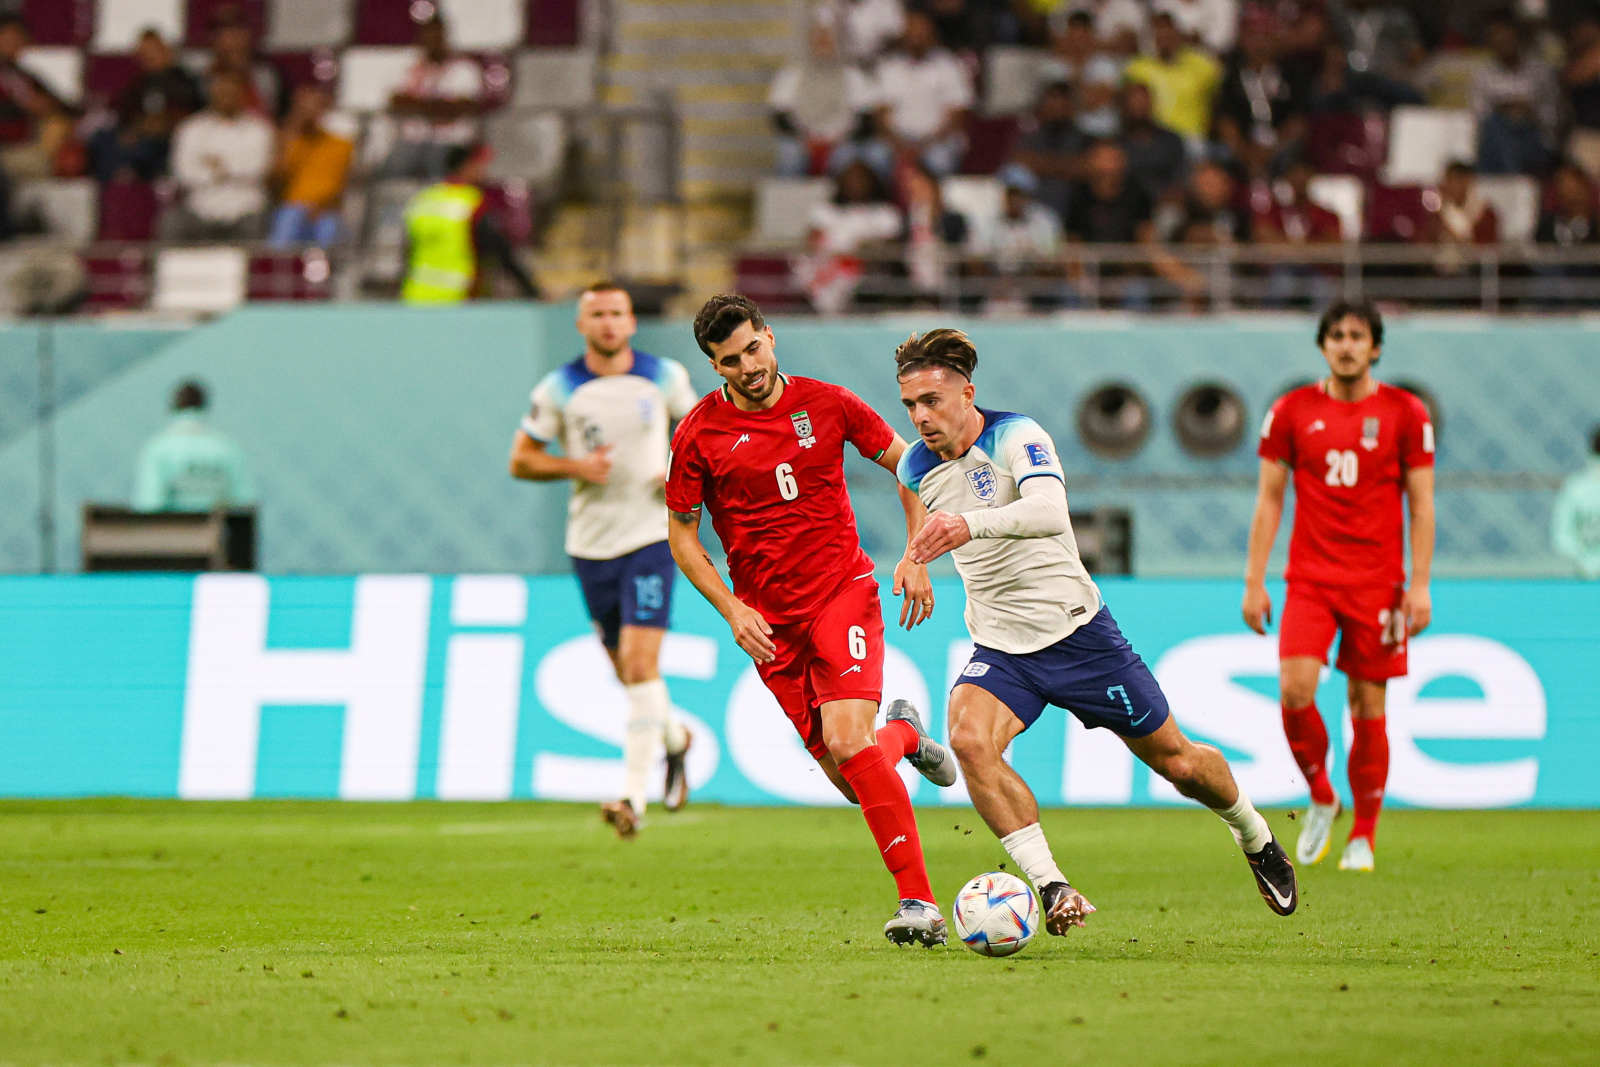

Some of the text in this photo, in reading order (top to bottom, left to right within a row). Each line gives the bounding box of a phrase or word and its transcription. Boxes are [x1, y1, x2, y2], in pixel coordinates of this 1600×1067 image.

[775, 462, 799, 501] 6
[1325, 448, 1359, 487] 20
[848, 625, 867, 660] 6
[1106, 684, 1134, 716] 7
